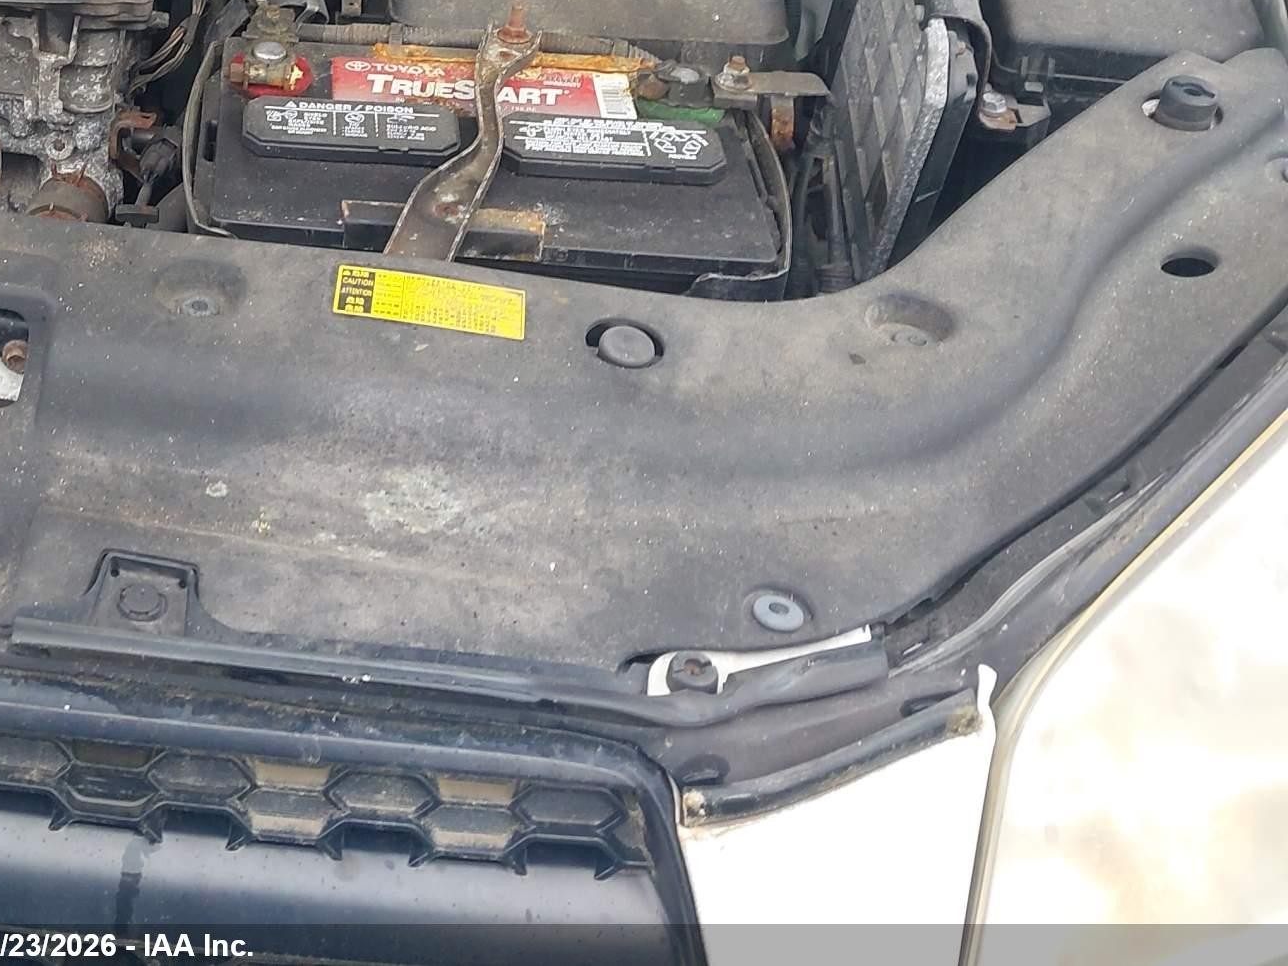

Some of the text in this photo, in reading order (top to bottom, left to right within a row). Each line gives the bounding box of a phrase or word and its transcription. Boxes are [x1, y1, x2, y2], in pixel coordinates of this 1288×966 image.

[372, 62, 445, 78] TOYOTA
[367, 73, 563, 105] TRUESART
[299, 101, 353, 112] DANGER
[365, 105, 414, 114] POISON
[342, 276, 374, 286] CAUTION
[341, 286, 372, 297] ATTENTION
